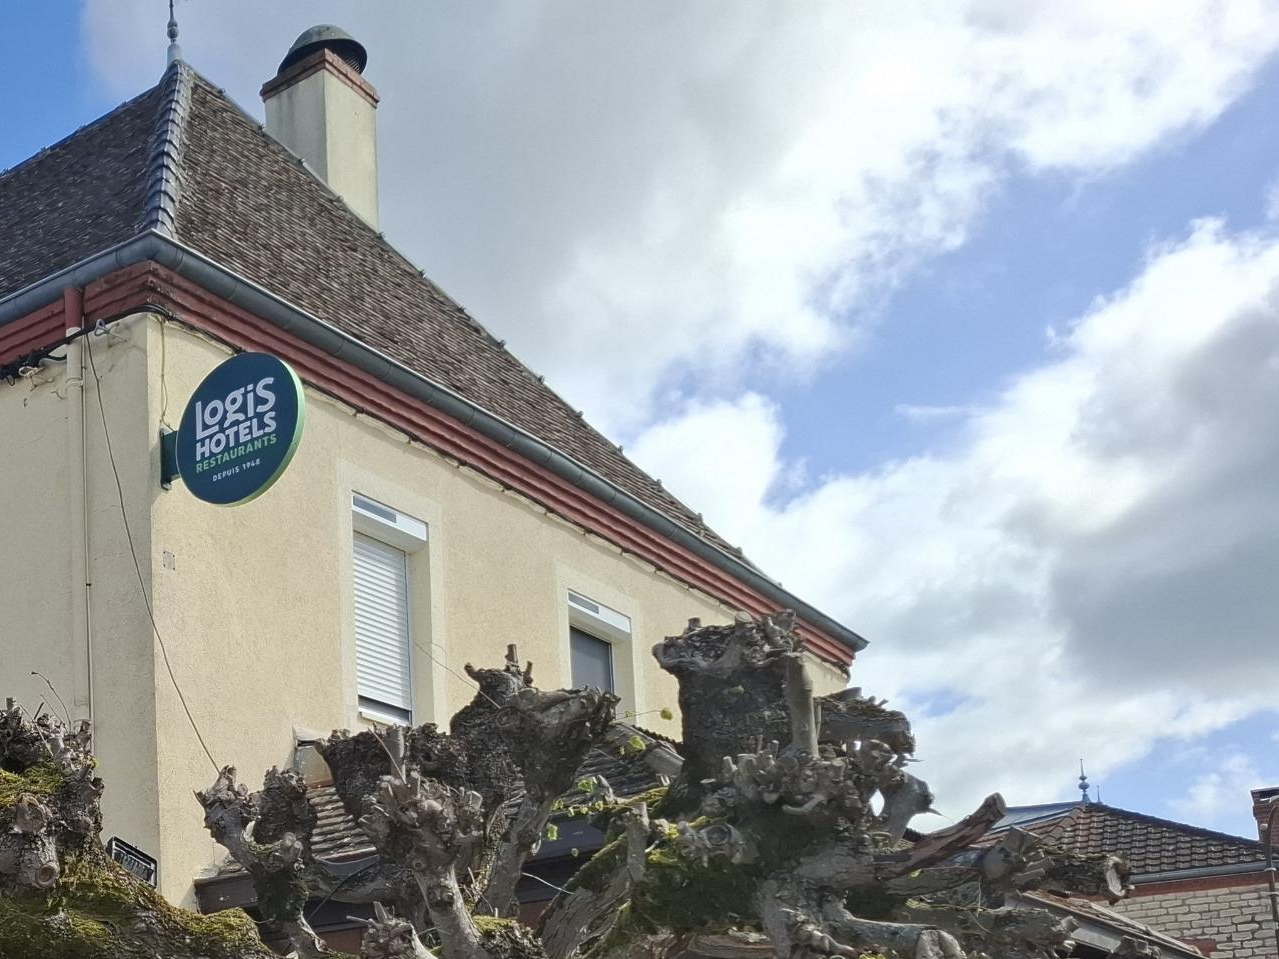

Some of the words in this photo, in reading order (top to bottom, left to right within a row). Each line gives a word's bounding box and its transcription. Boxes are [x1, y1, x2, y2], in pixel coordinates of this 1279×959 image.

[195, 411, 277, 461] HOTELS
[195, 433, 278, 473] RESTAURANTS
[212, 466, 240, 482] DEPUIS
